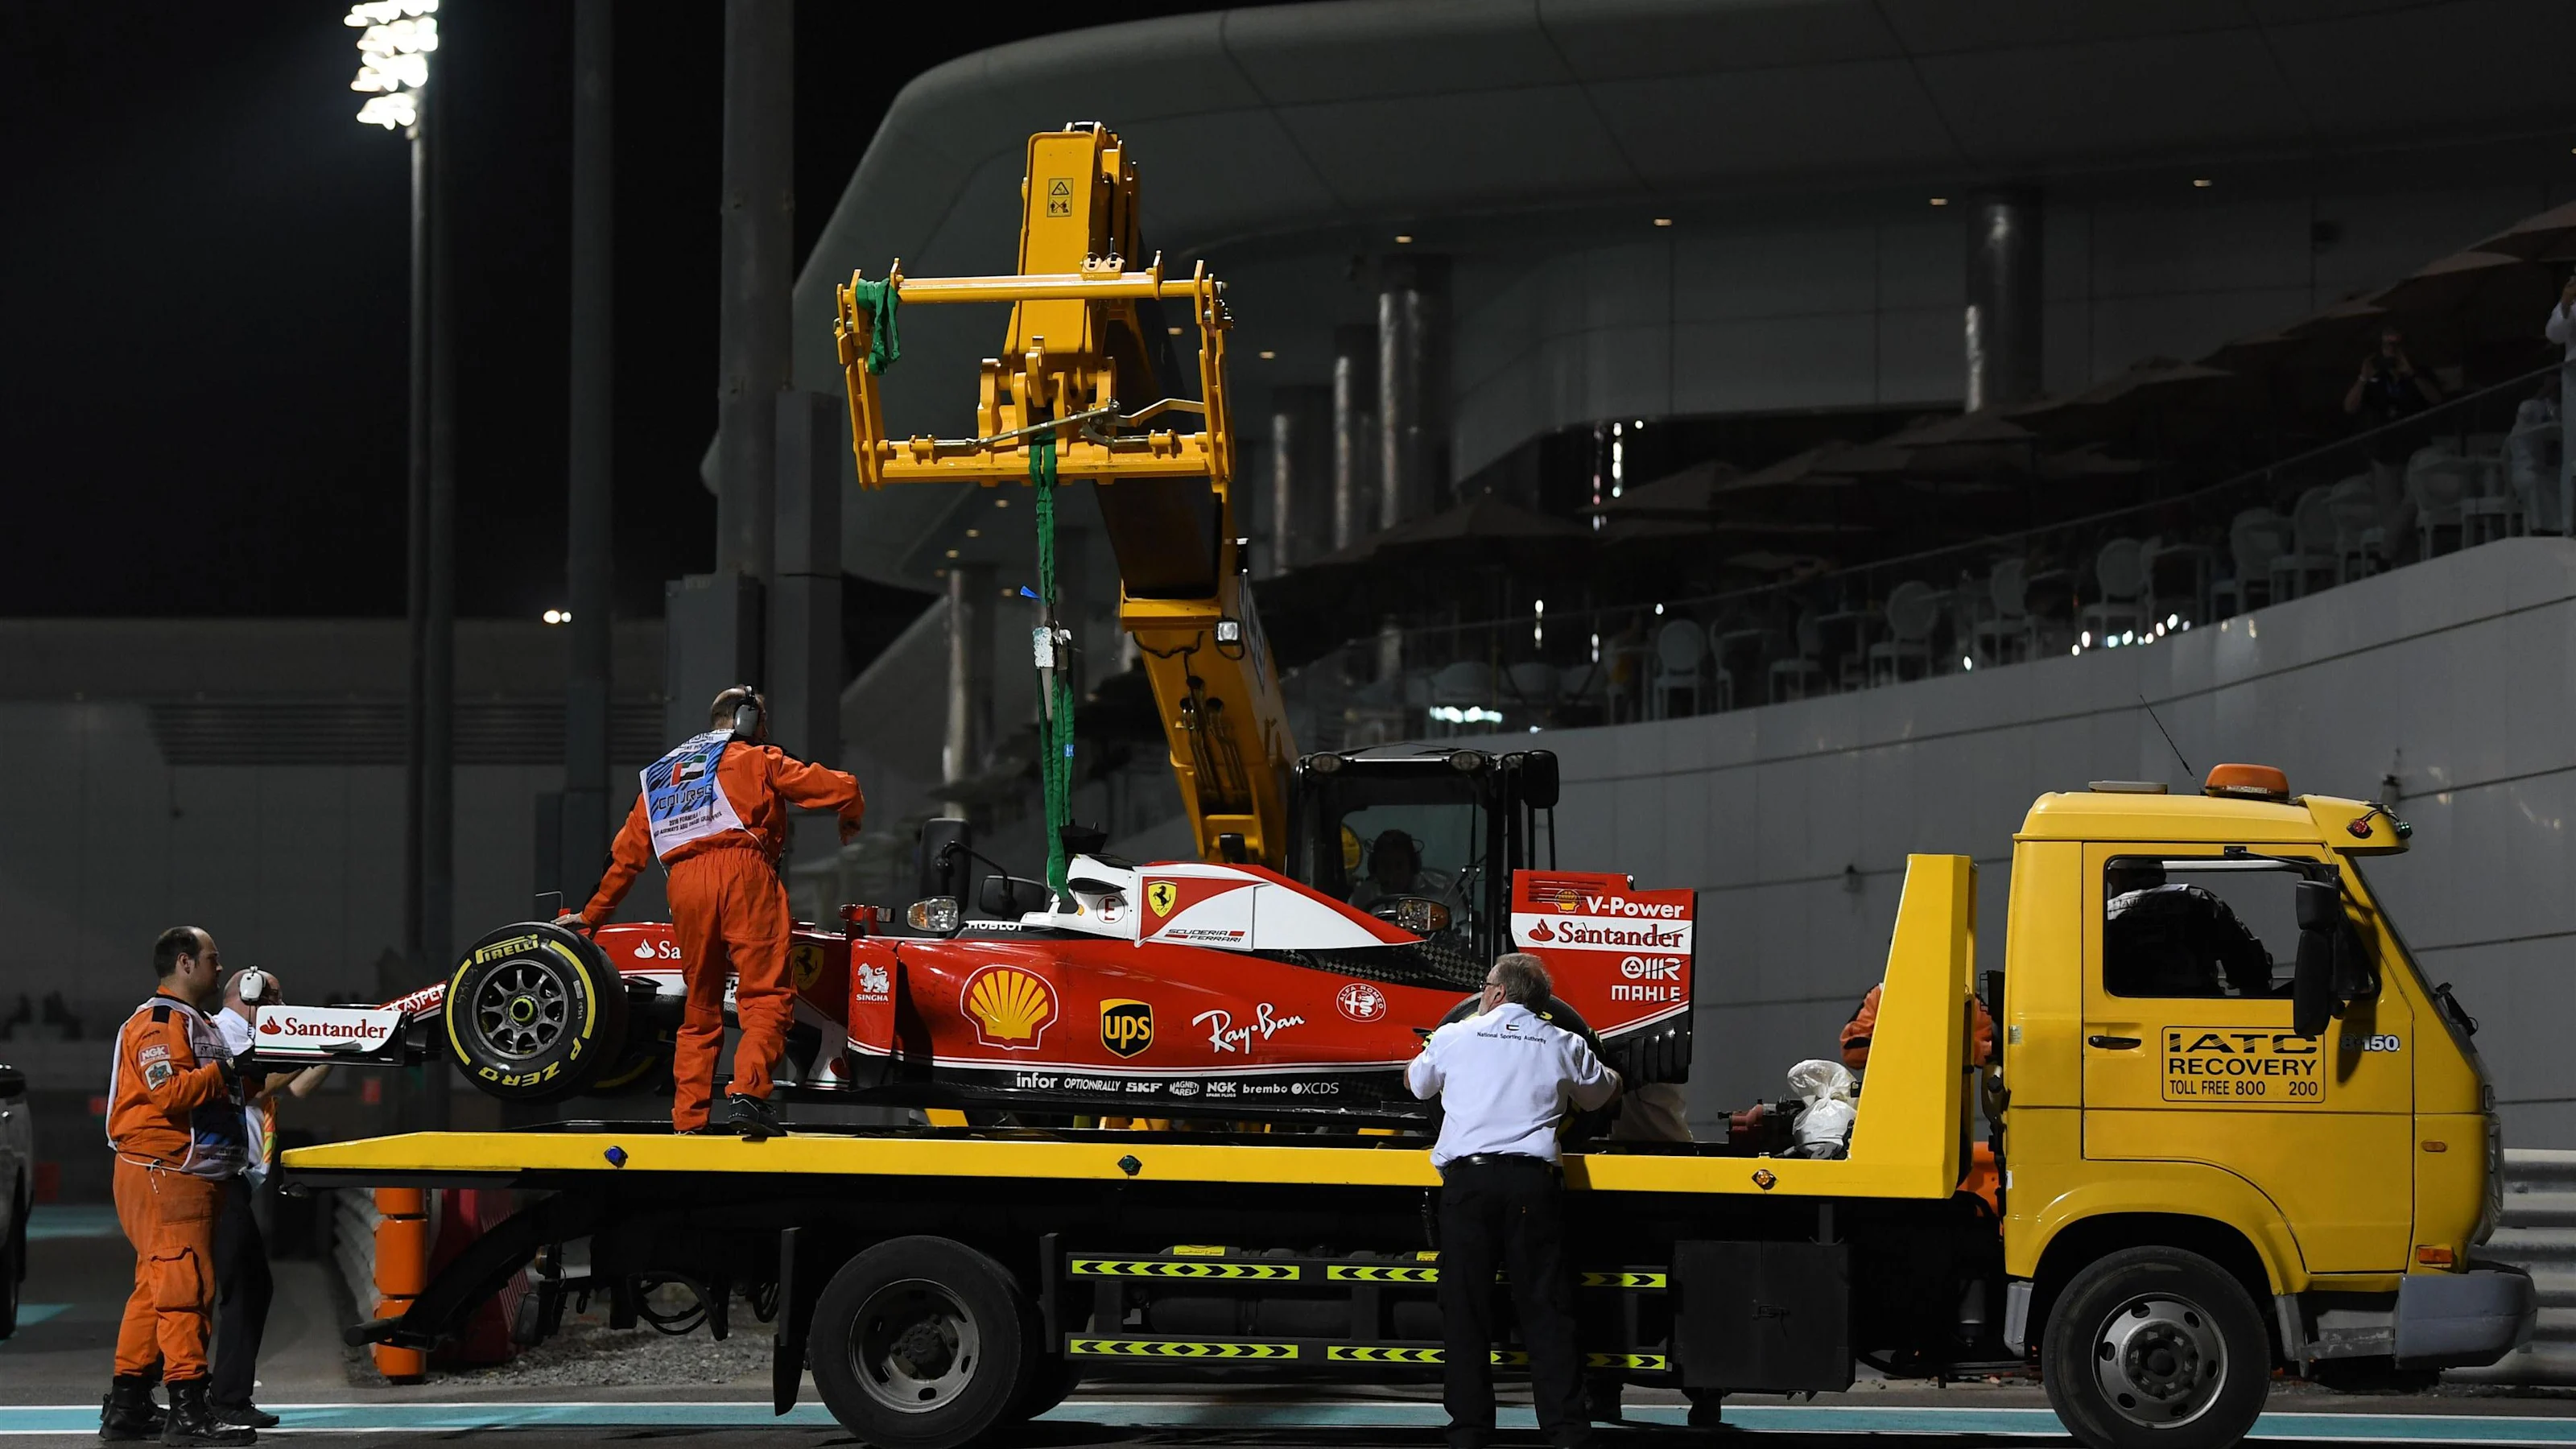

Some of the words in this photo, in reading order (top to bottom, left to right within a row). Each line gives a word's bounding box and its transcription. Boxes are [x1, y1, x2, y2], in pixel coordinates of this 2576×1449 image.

[1104, 898, 1115, 921] E
[1586, 896, 1684, 918] V-Power
[1168, 928, 1228, 936] SCUDERIA
[1558, 921, 1683, 947] Santander
[475, 934, 539, 964] PIRELLI
[1339, 985, 1357, 1002] ALFA
[1360, 985, 1384, 1009] ROMEO
[1611, 985, 1680, 1002] MAHLE
[285, 1018, 387, 1038] Santander
[1104, 1015, 1151, 1049] ups
[570, 1036, 582, 1060] P
[1524, 1035, 1546, 1044] Authority
[2169, 1034, 2317, 1054] IATC
[142, 1046, 167, 1059] NGK
[478, 1061, 560, 1087] ZERO
[2169, 1059, 2317, 1075] RECOVERY
[1017, 1072, 1058, 1088] infor
[1126, 1082, 1162, 1092] SKF
[1208, 1082, 1236, 1092] NGK
[1243, 1084, 1287, 1094] brembo
[2169, 1080, 2197, 1095] TOLL
[2202, 1081, 2229, 1095] FREE
[2235, 1081, 2265, 1096] 800
[2289, 1082, 2318, 1096] 200
